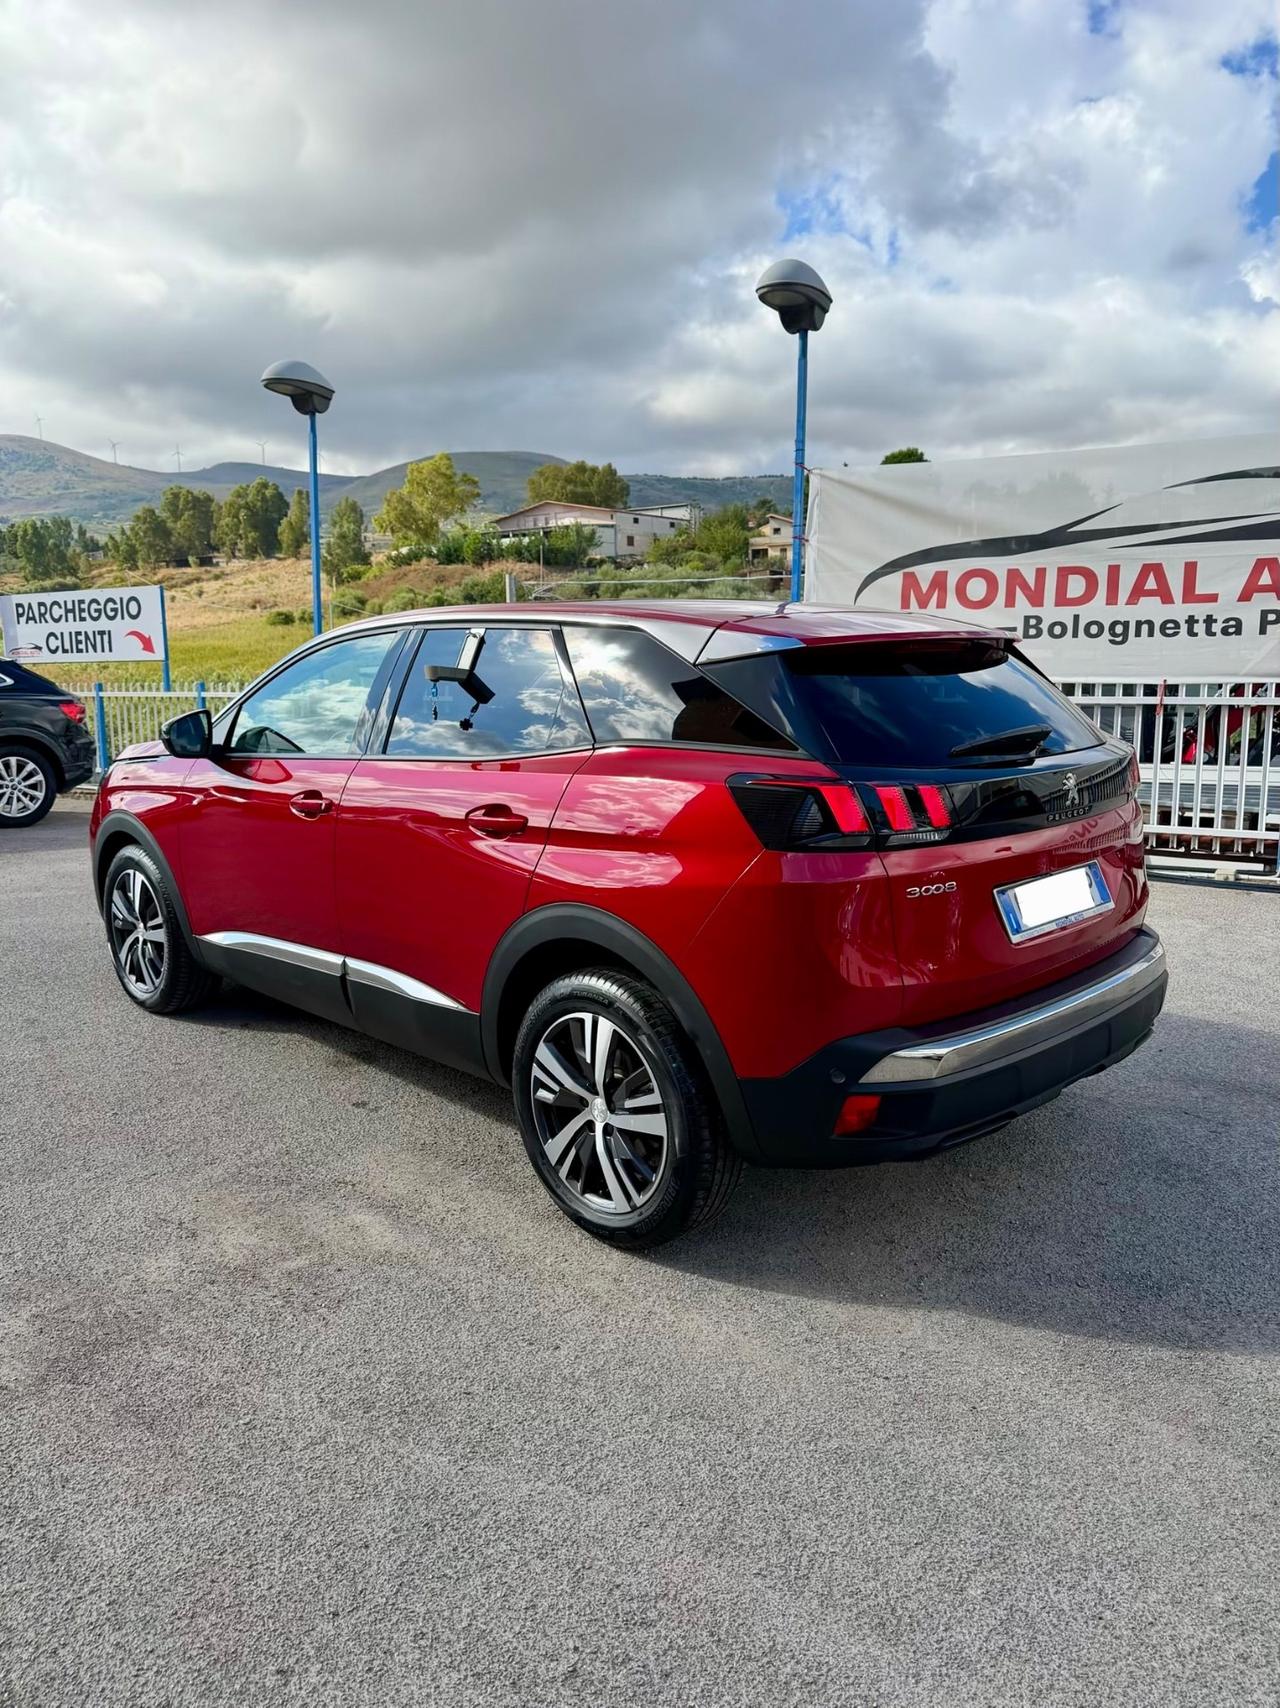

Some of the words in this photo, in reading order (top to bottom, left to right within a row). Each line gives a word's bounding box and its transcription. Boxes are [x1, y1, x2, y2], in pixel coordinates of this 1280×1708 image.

[901, 560, 1219, 610] MONDIAL
[15, 595, 142, 625] PARCHEGGIO
[45, 629, 113, 655] CLIENTI
[1022, 613, 1243, 645] Bolognetta
[1048, 806, 1089, 821] PEUGEOT
[906, 881, 958, 898] 3008
